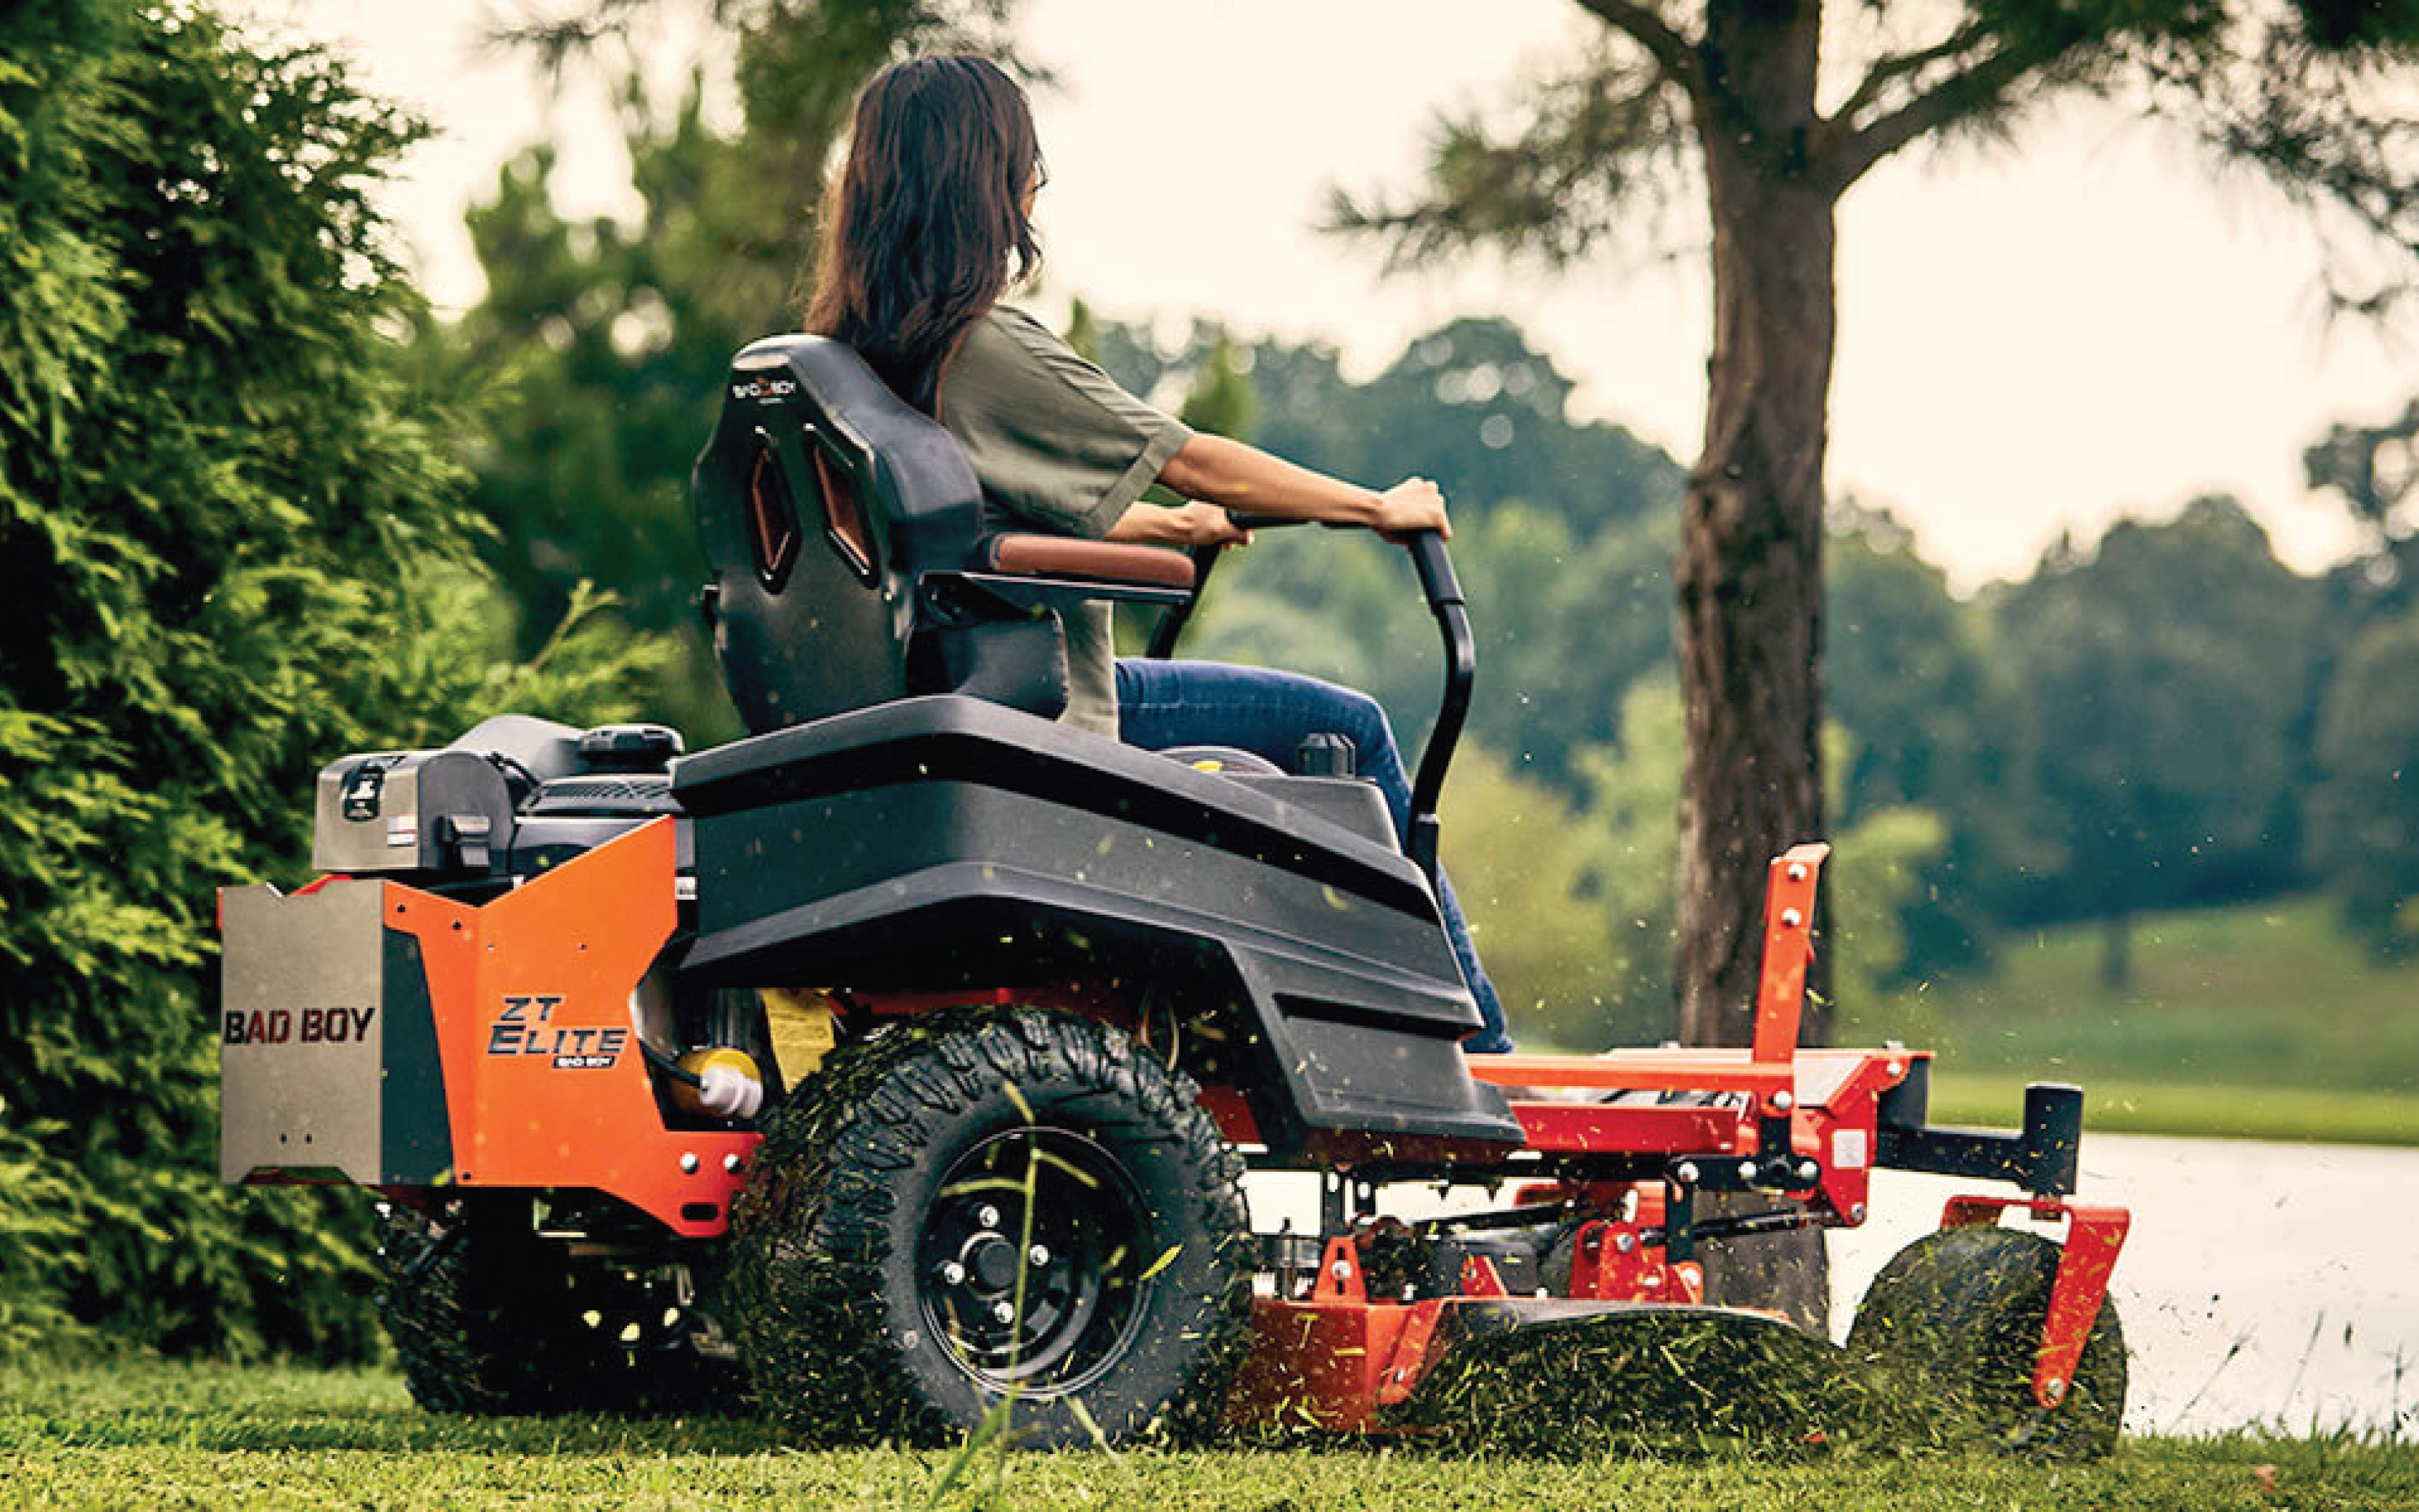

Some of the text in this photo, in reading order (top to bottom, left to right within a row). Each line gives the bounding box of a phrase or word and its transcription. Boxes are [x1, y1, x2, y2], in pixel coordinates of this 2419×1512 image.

[500, 996, 562, 1021] ZT
[225, 1007, 375, 1044] BAD BOY
[488, 1024, 628, 1054] ELITE
